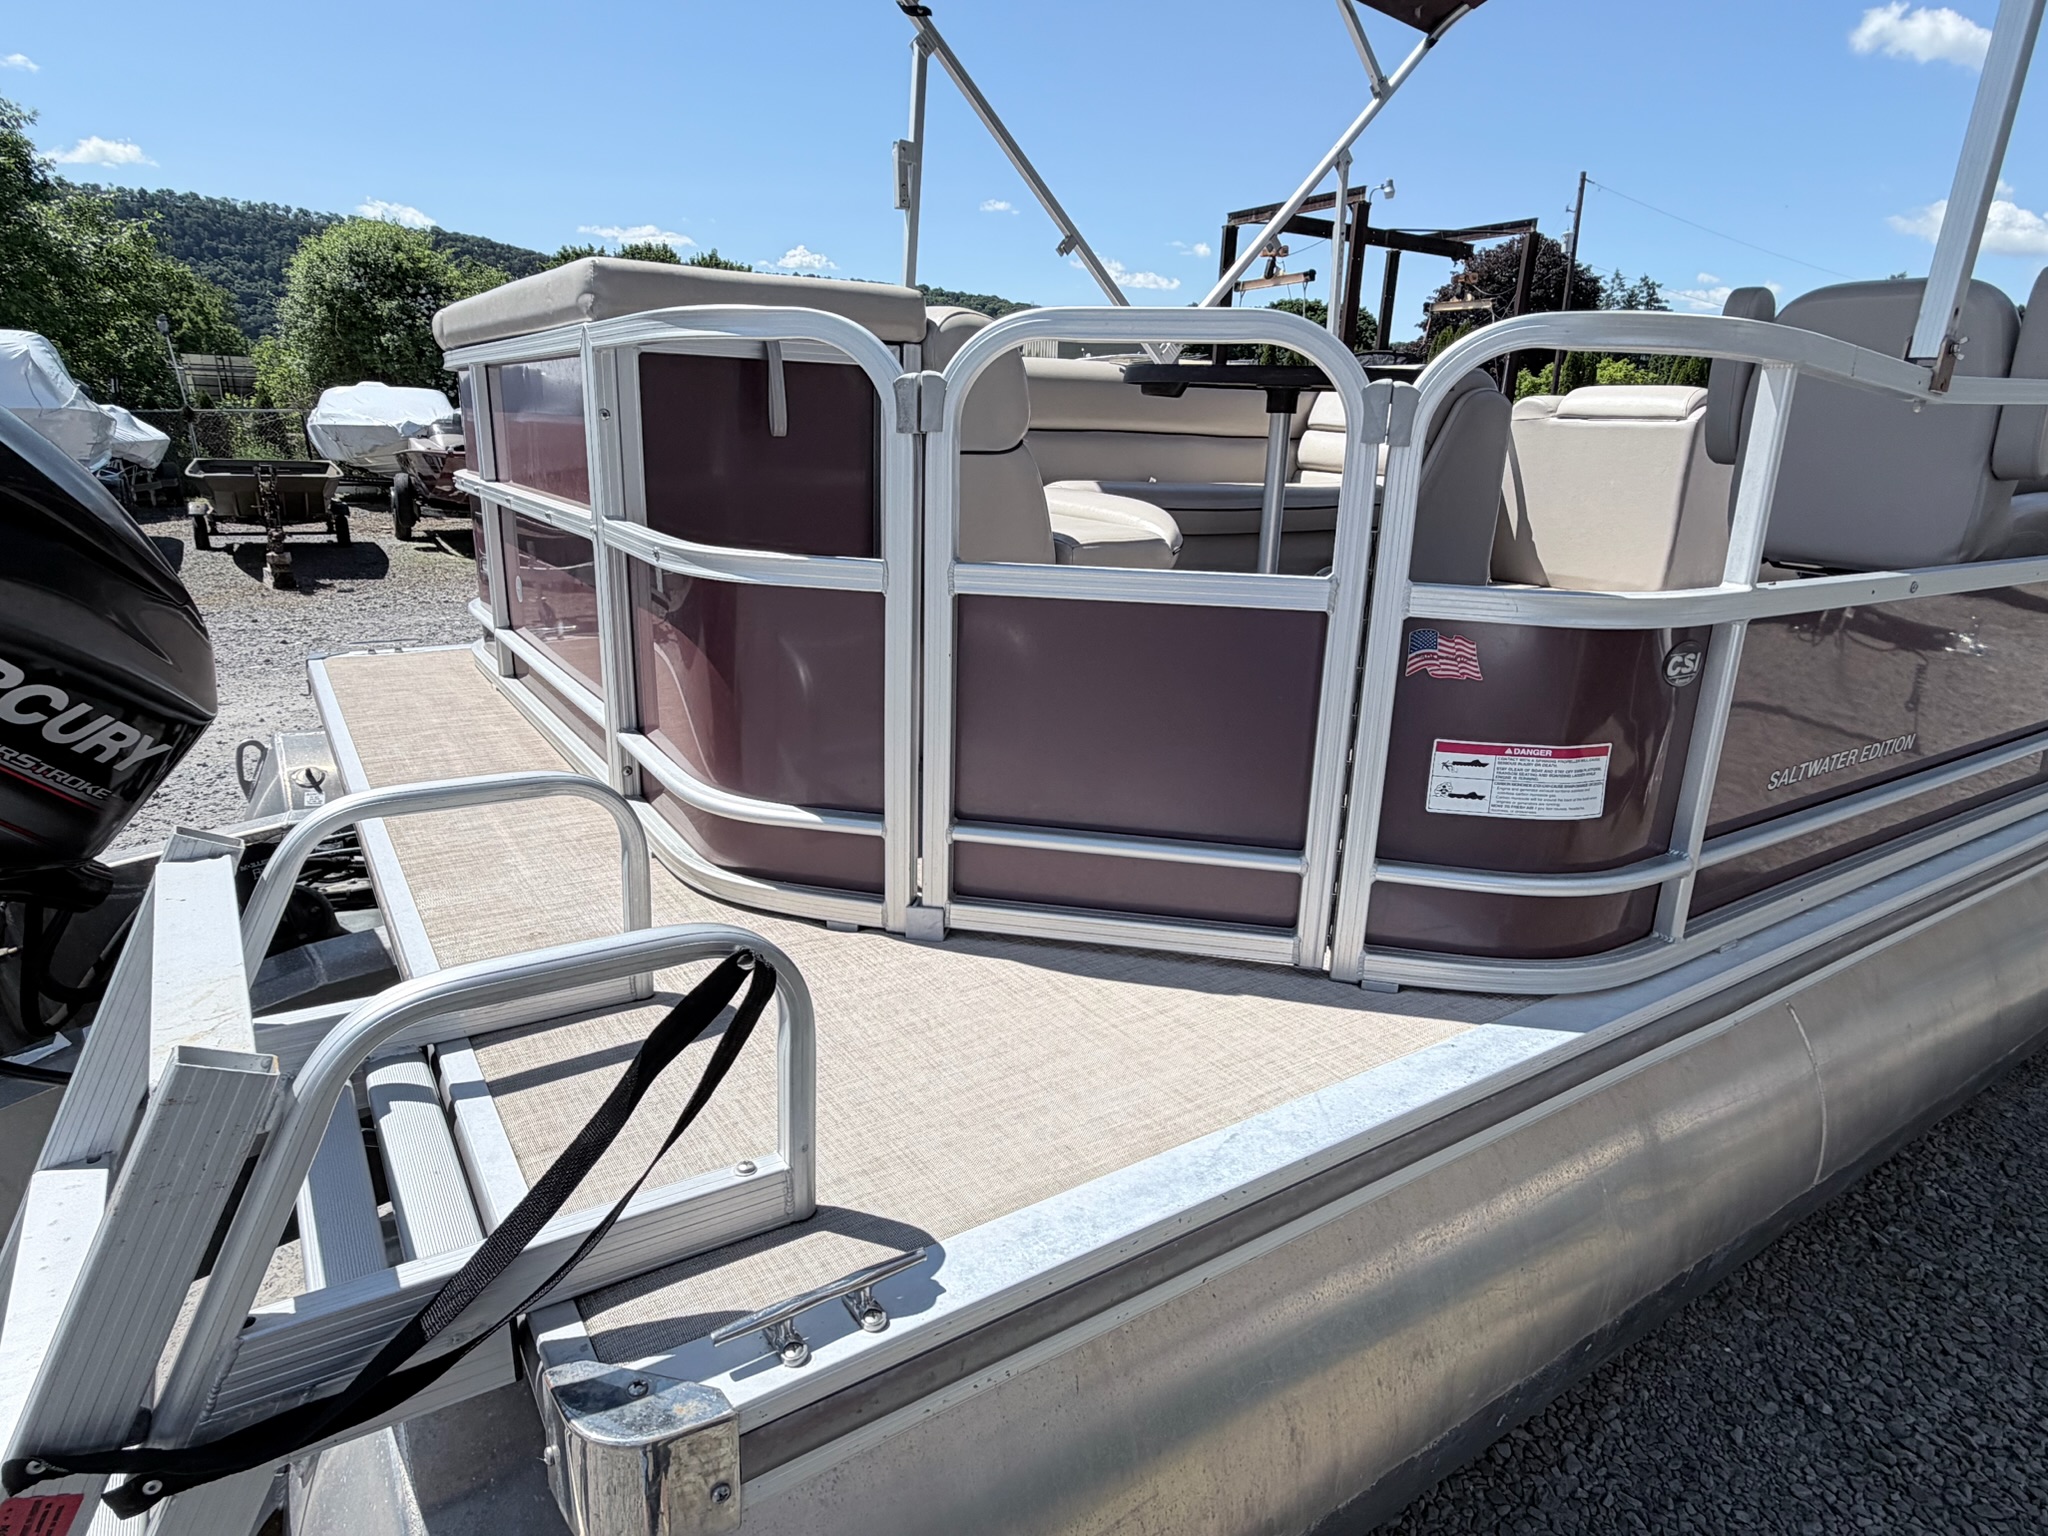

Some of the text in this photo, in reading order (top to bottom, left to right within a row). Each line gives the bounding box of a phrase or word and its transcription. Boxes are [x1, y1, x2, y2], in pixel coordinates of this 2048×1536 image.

[1513, 748, 1553, 757] DANGER
[1767, 733, 1916, 790] SALTWATER EDITION
